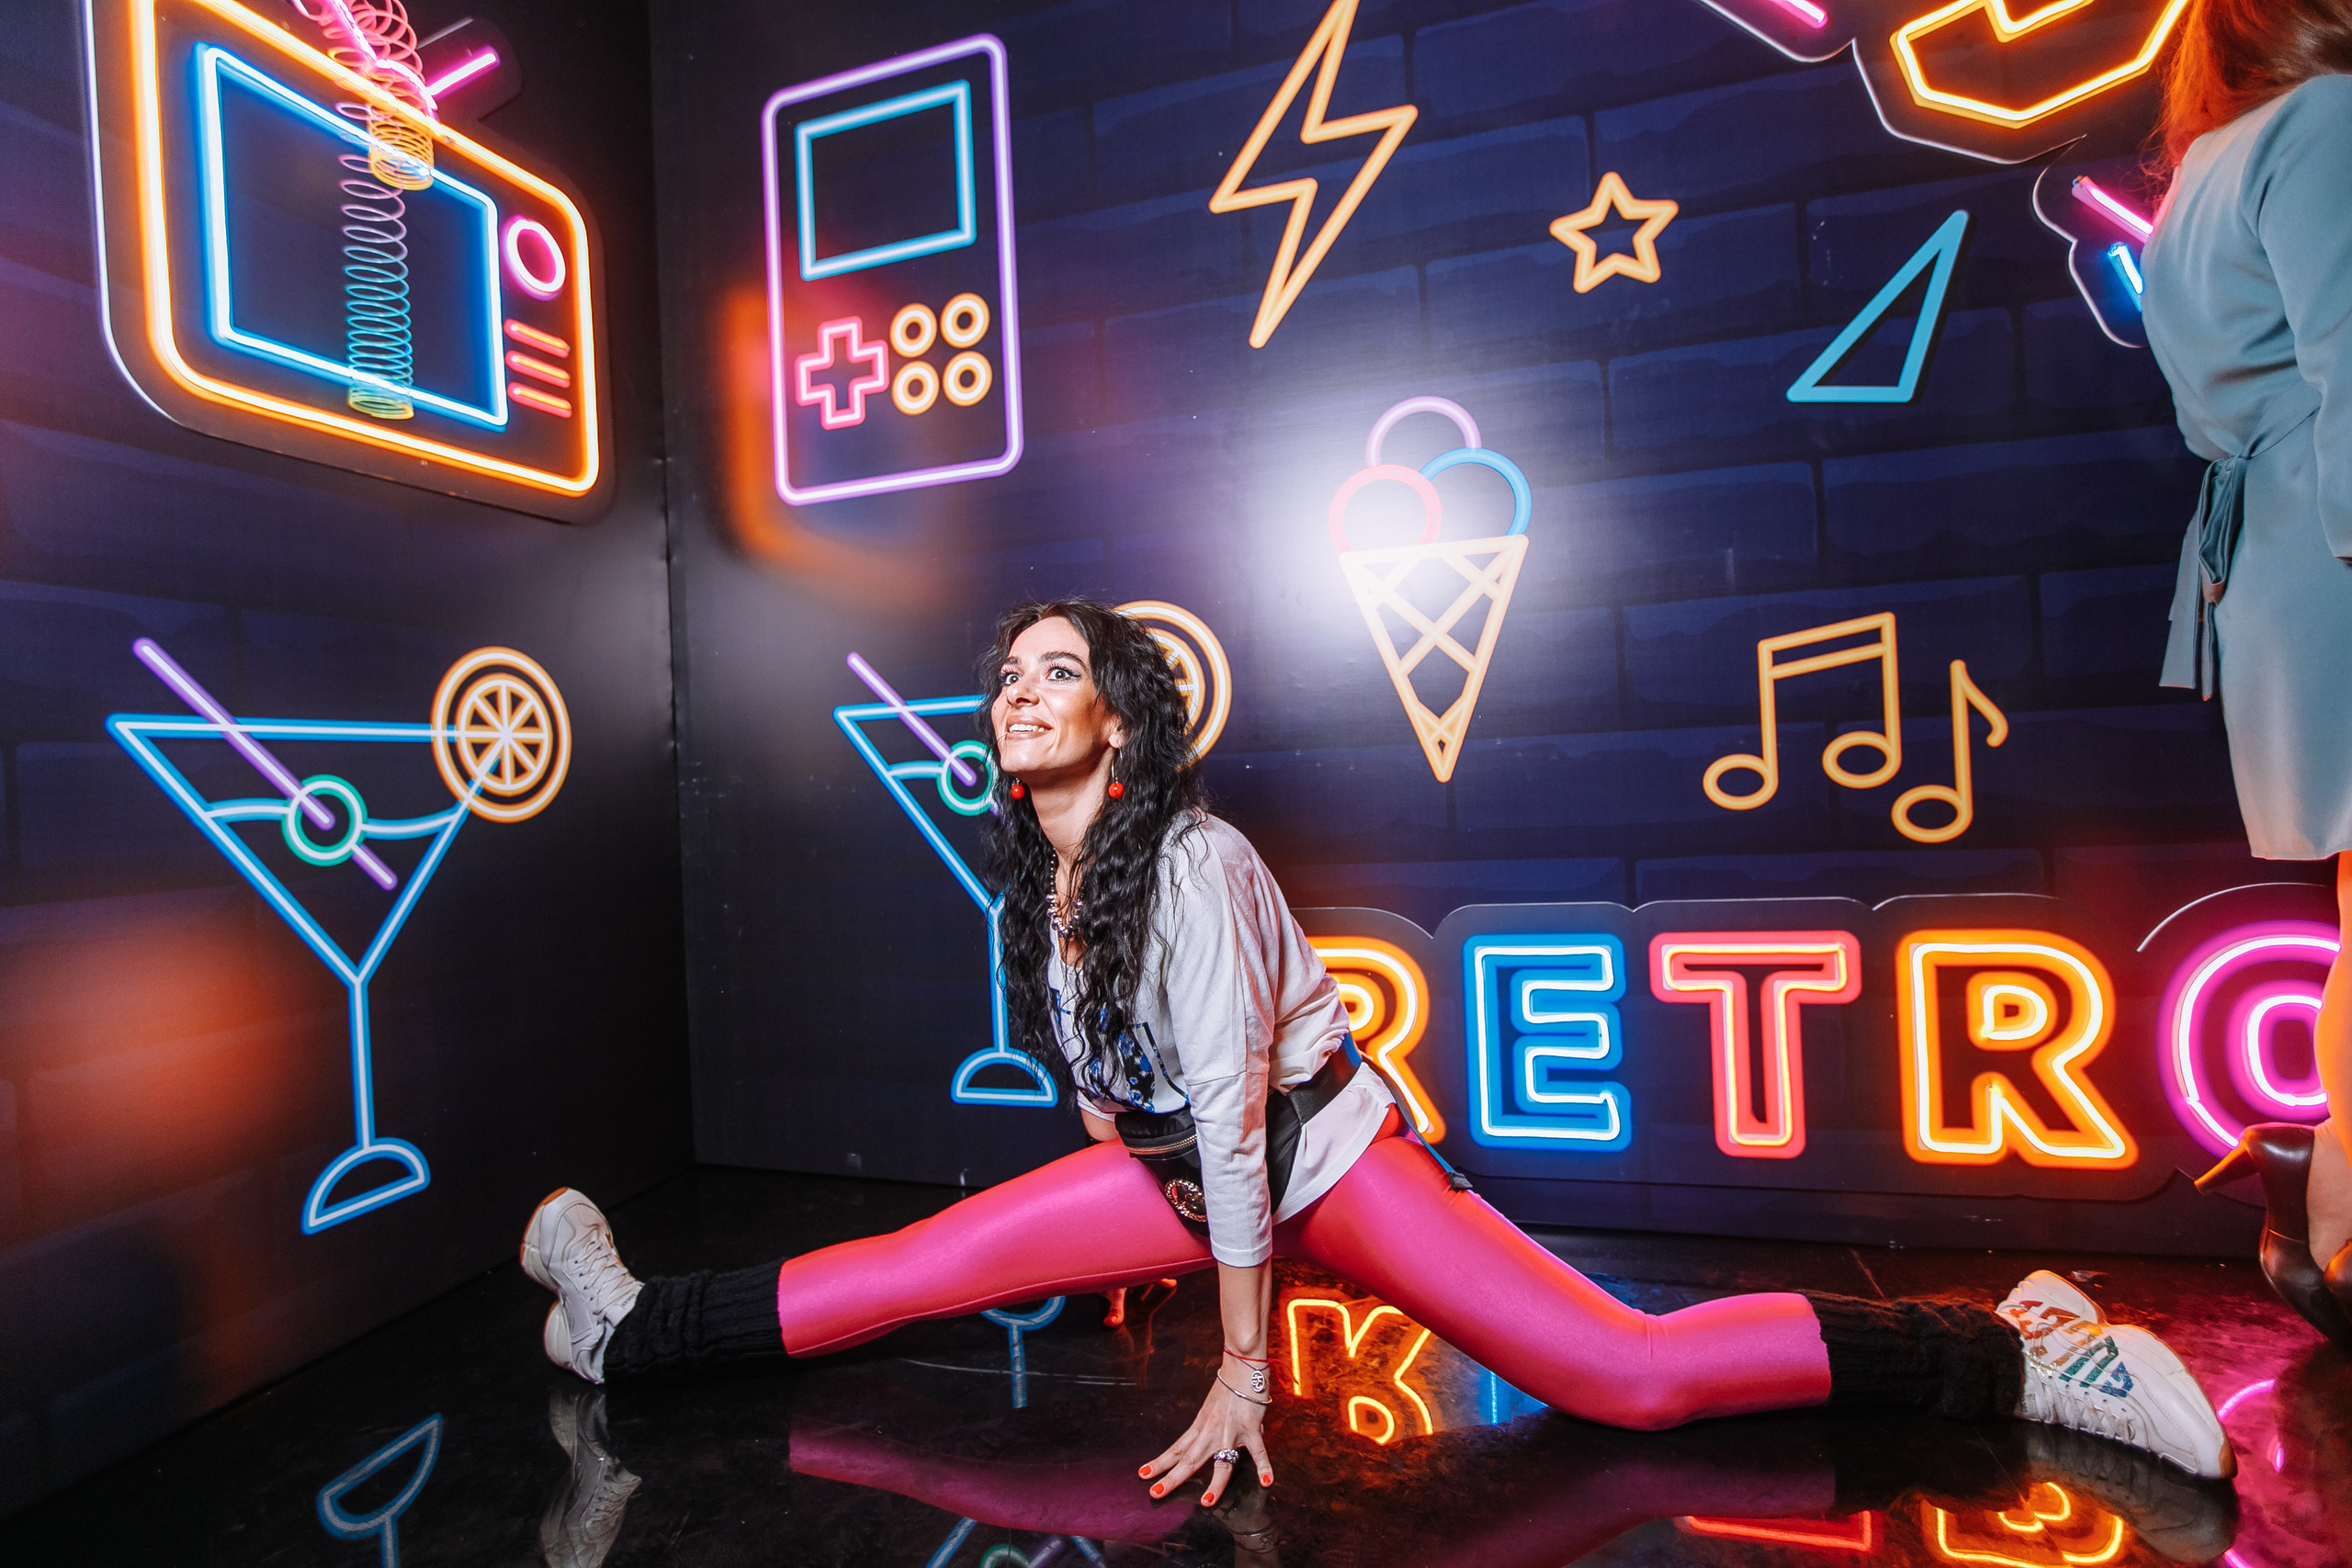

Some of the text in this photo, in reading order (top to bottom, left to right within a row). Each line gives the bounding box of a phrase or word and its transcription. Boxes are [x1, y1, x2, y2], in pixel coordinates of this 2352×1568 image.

[1306, 919, 2341, 1169] RETRO
[621, 1293, 637, 1306] GUCCI
[2009, 1300, 2134, 1398] GUCCI
